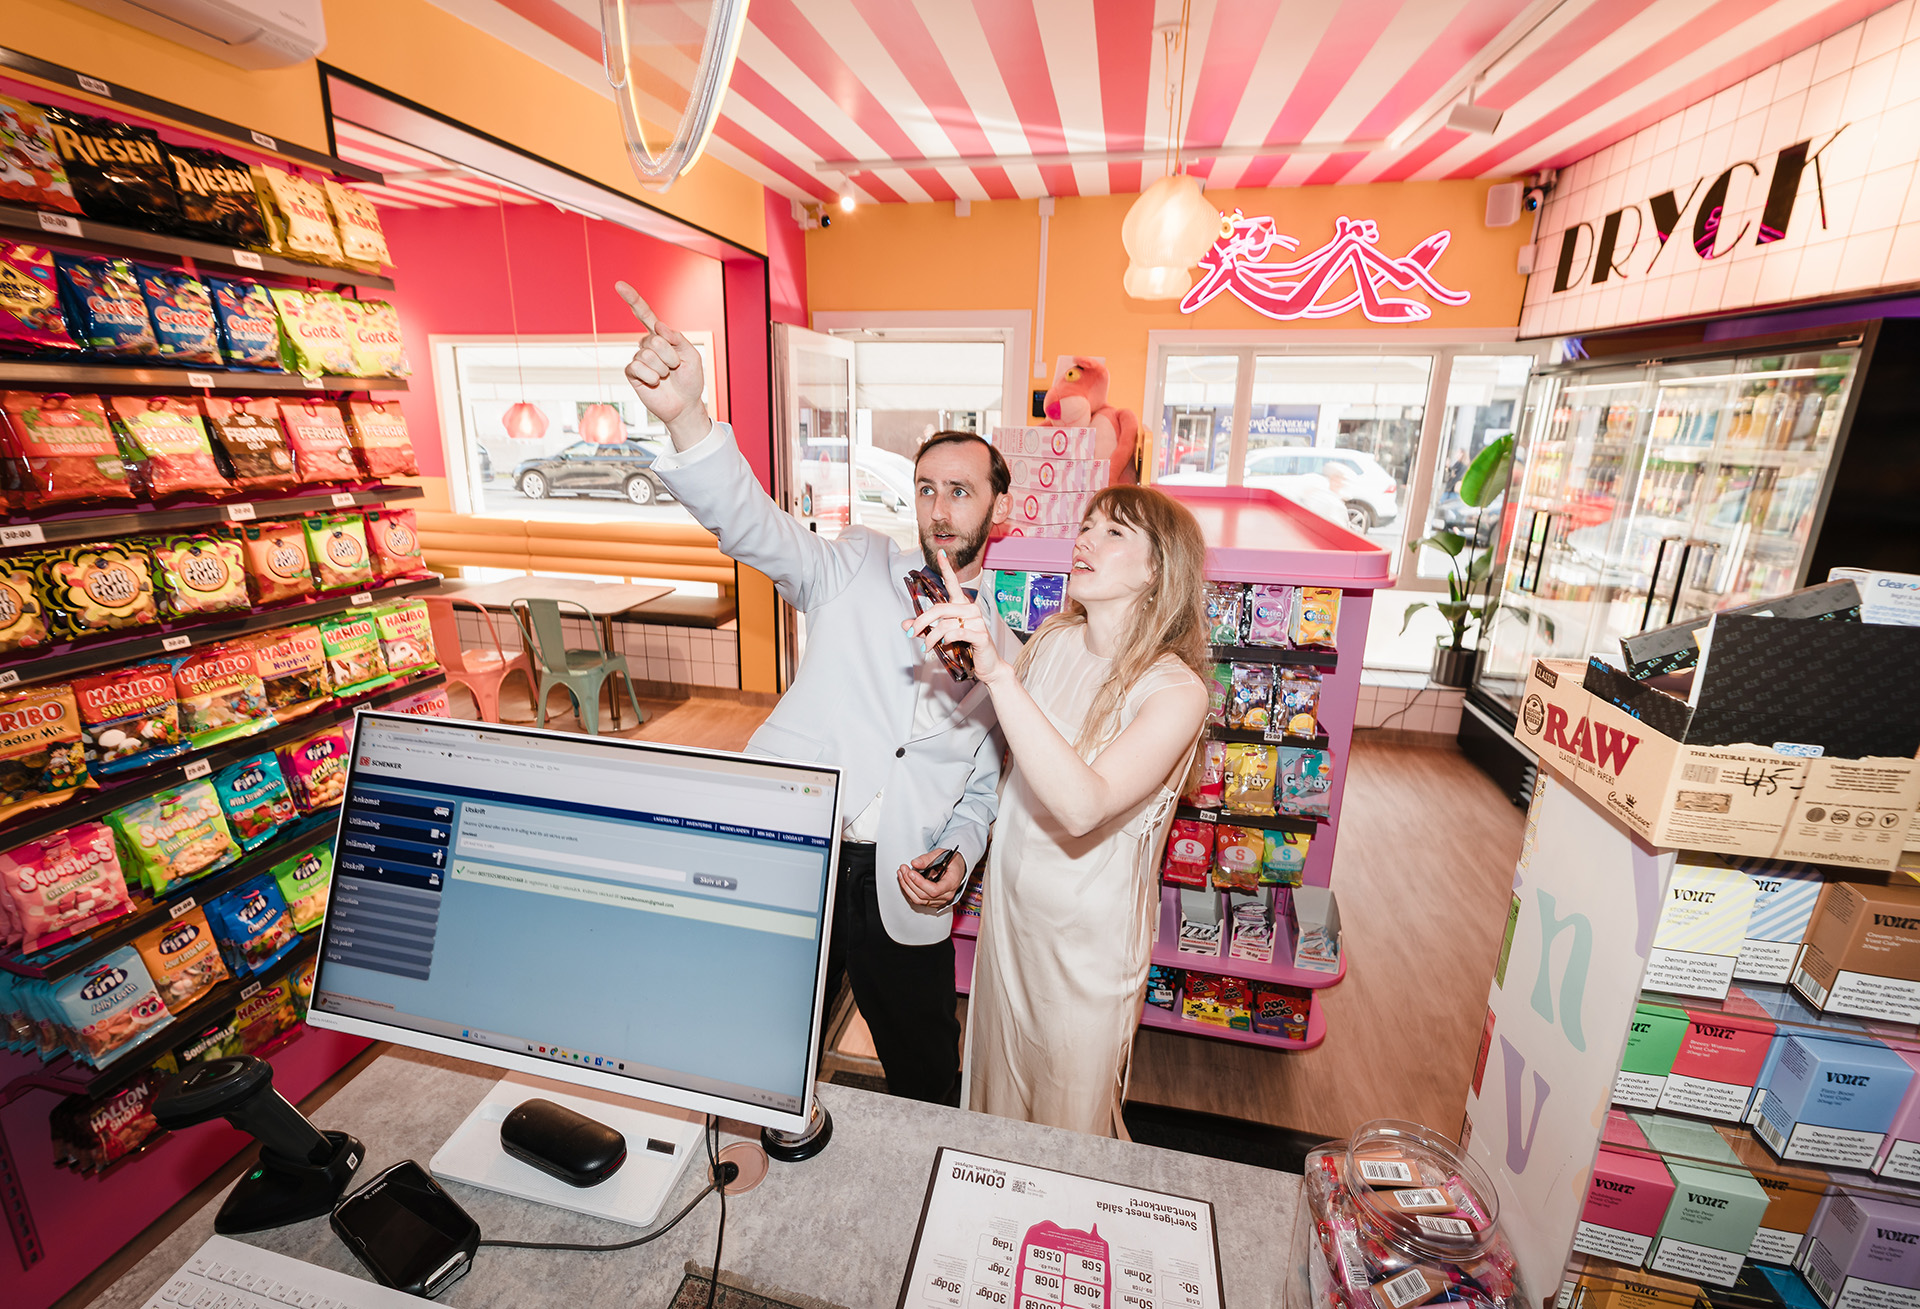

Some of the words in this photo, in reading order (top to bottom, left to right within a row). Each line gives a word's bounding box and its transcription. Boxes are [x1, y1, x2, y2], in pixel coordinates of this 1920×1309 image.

[51, 123, 163, 167] RIESEN
[168, 155, 255, 196] RIESEN
[1553, 122, 1850, 293] DRYCK
[26, 425, 112, 444] FERRARI
[222, 427, 283, 443] FERRARI
[297, 426, 346, 441] FERRARI
[1877, 578, 1907, 590] Clear
[997, 591, 1023, 603] extra
[1033, 597, 1060, 609] extra
[385, 608, 426, 628] HARIBO
[1207, 604, 1233, 617] extra
[1257, 606, 1282, 618] extra
[1304, 609, 1330, 621] extra
[324, 621, 372, 645] HARIBO
[256, 637, 317, 663] HARIBO
[179, 654, 251, 685] HARIBO
[1535, 665, 1557, 688] CLASSIC
[87, 675, 168, 708] HARIBO
[1238, 688, 1267, 702] extra
[142, 695, 166, 711] Mix
[1284, 693, 1314, 706] extra
[40, 724, 66, 742] Mix
[1543, 702, 1640, 777] RAW
[1690, 750, 1708, 759] THE
[1708, 752, 1747, 763] NATURAL
[1748, 757, 1769, 765] WAY
[1558, 750, 1577, 768] CLASSIC
[1576, 760, 1597, 777] ROLLING
[1596, 769, 1616, 786] PAPERS
[232, 769, 266, 792] Fini
[1224, 771, 1271, 791] Goody
[1284, 773, 1332, 793] Goody
[353, 795, 381, 806] Ankomst
[464, 806, 487, 816] Utskrift
[1201, 812, 1216, 820] 20:00
[1607, 790, 1652, 830] Connoisseur
[348, 816, 381, 830] Utlämning
[345, 838, 377, 852] Inlämning
[1184, 842, 1195, 855] S
[1235, 848, 1246, 861] S
[1282, 848, 1292, 861] S
[1783, 849, 1891, 867] www.rawthentic.com
[292, 857, 322, 881] Fini
[341, 861, 366, 873] Utskrift
[240, 894, 268, 920] Fini
[159, 924, 199, 955] Fini
[196, 939, 210, 954] Mix
[1649, 962, 1685, 973] innehåller
[1686, 967, 1711, 976] nikotin
[1664, 956, 1688, 966] Denna
[1688, 960, 1718, 969] produkt
[81, 966, 127, 1000] Fini
[1193, 980, 1206, 988] POP
[1649, 978, 1696, 990] framkallande
[1696, 983, 1719, 993] ämne.
[1664, 972, 1692, 983] mycket
[1691, 976, 1729, 986] beroende-
[1223, 991, 1242, 1000] ROCKS
[1224, 986, 1238, 994] POP
[90, 998, 111, 1016] Jelly
[110, 982, 138, 1005] Teeth
[1263, 999, 1286, 1011] POP
[1260, 1005, 1294, 1019] ROCKS
[1668, 1086, 1703, 1097] innehåller
[1703, 1091, 1727, 1101] nikotin
[1683, 1081, 1706, 1091] Denna
[1706, 1086, 1734, 1096] produkt
[90, 1082, 149, 1132] HALLON
[1668, 1100, 1712, 1112] framkallande
[1712, 1107, 1734, 1116] ämne.
[1683, 1095, 1708, 1106] mycket
[1708, 1099, 1744, 1111] beroende-
[109, 1102, 145, 1131] SHOTS
[951, 1166, 1006, 1189] COMVIQ
[1096, 1200, 1123, 1214] sålda
[1125, 1207, 1151, 1219] mest
[1129, 1197, 1197, 1221] kontantkort!
[1153, 1212, 1198, 1231] Sveriges
